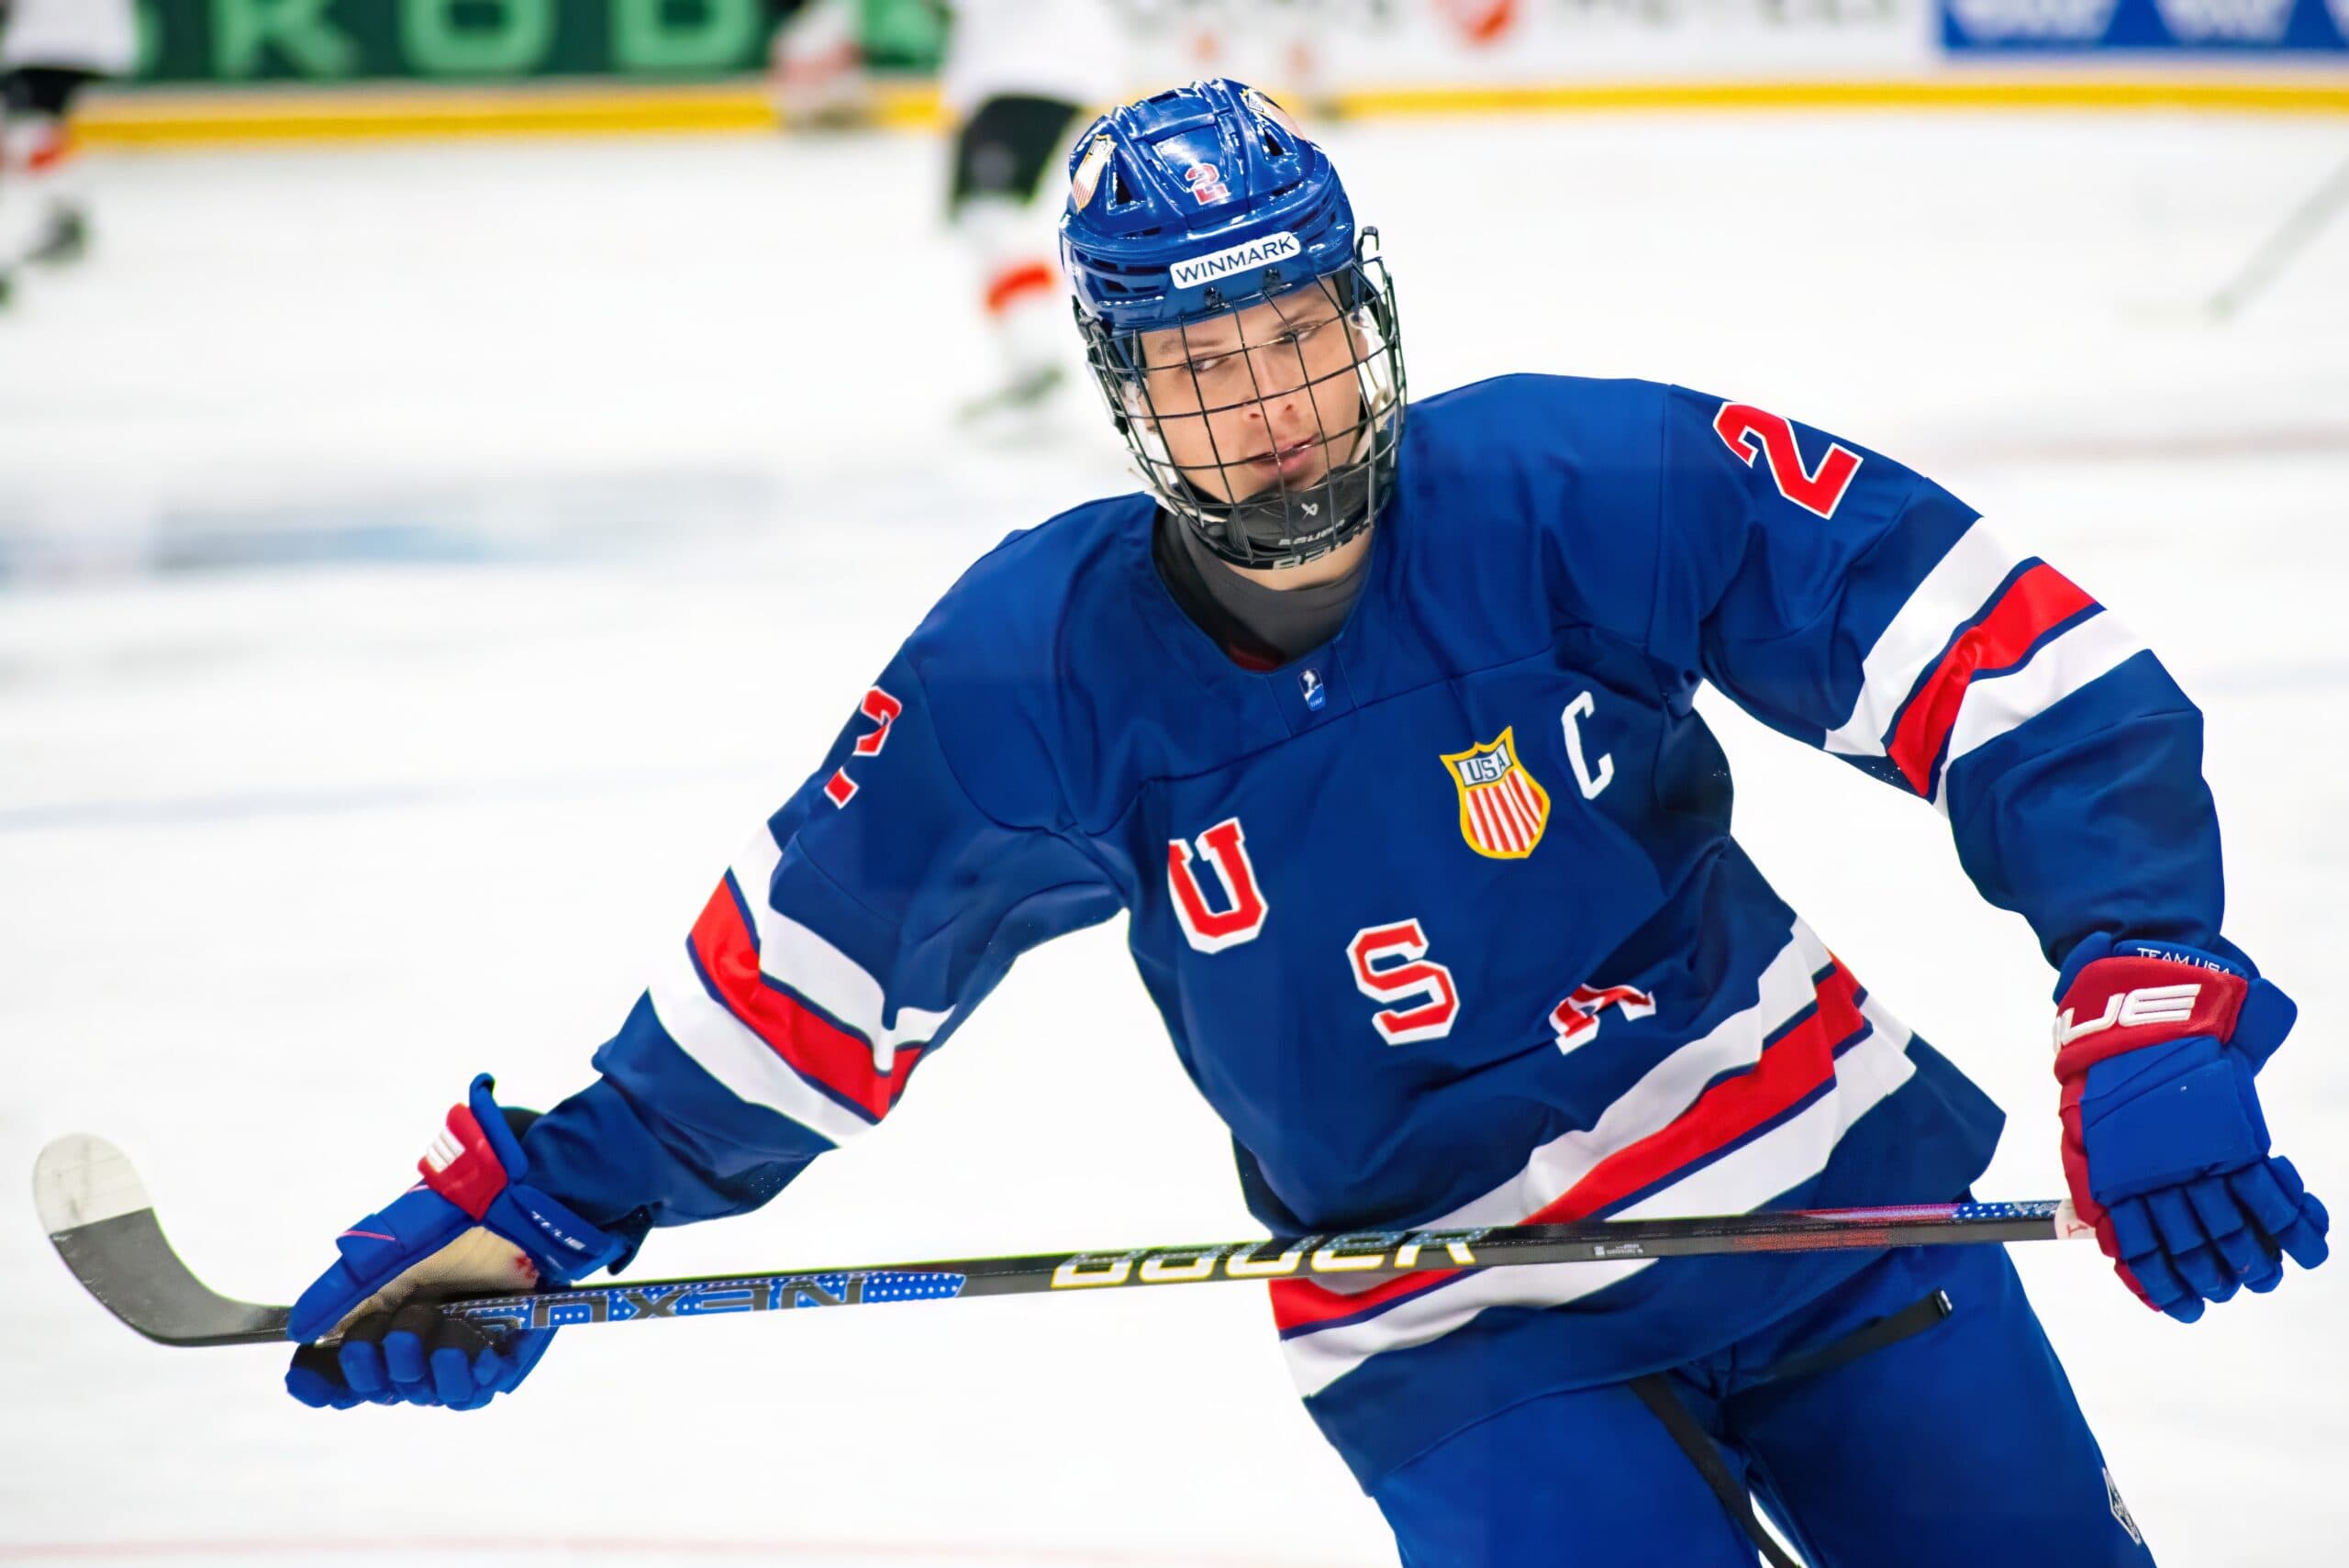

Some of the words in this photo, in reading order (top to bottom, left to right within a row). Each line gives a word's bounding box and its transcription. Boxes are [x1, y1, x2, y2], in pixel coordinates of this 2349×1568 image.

[1185, 162, 1230, 206] 2
[1175, 236, 1296, 283] WINMARK
[1713, 401, 1864, 520] 2
[1466, 751, 1507, 782] USA
[1561, 691, 1615, 800] C
[2137, 948, 2189, 965] TEAM
